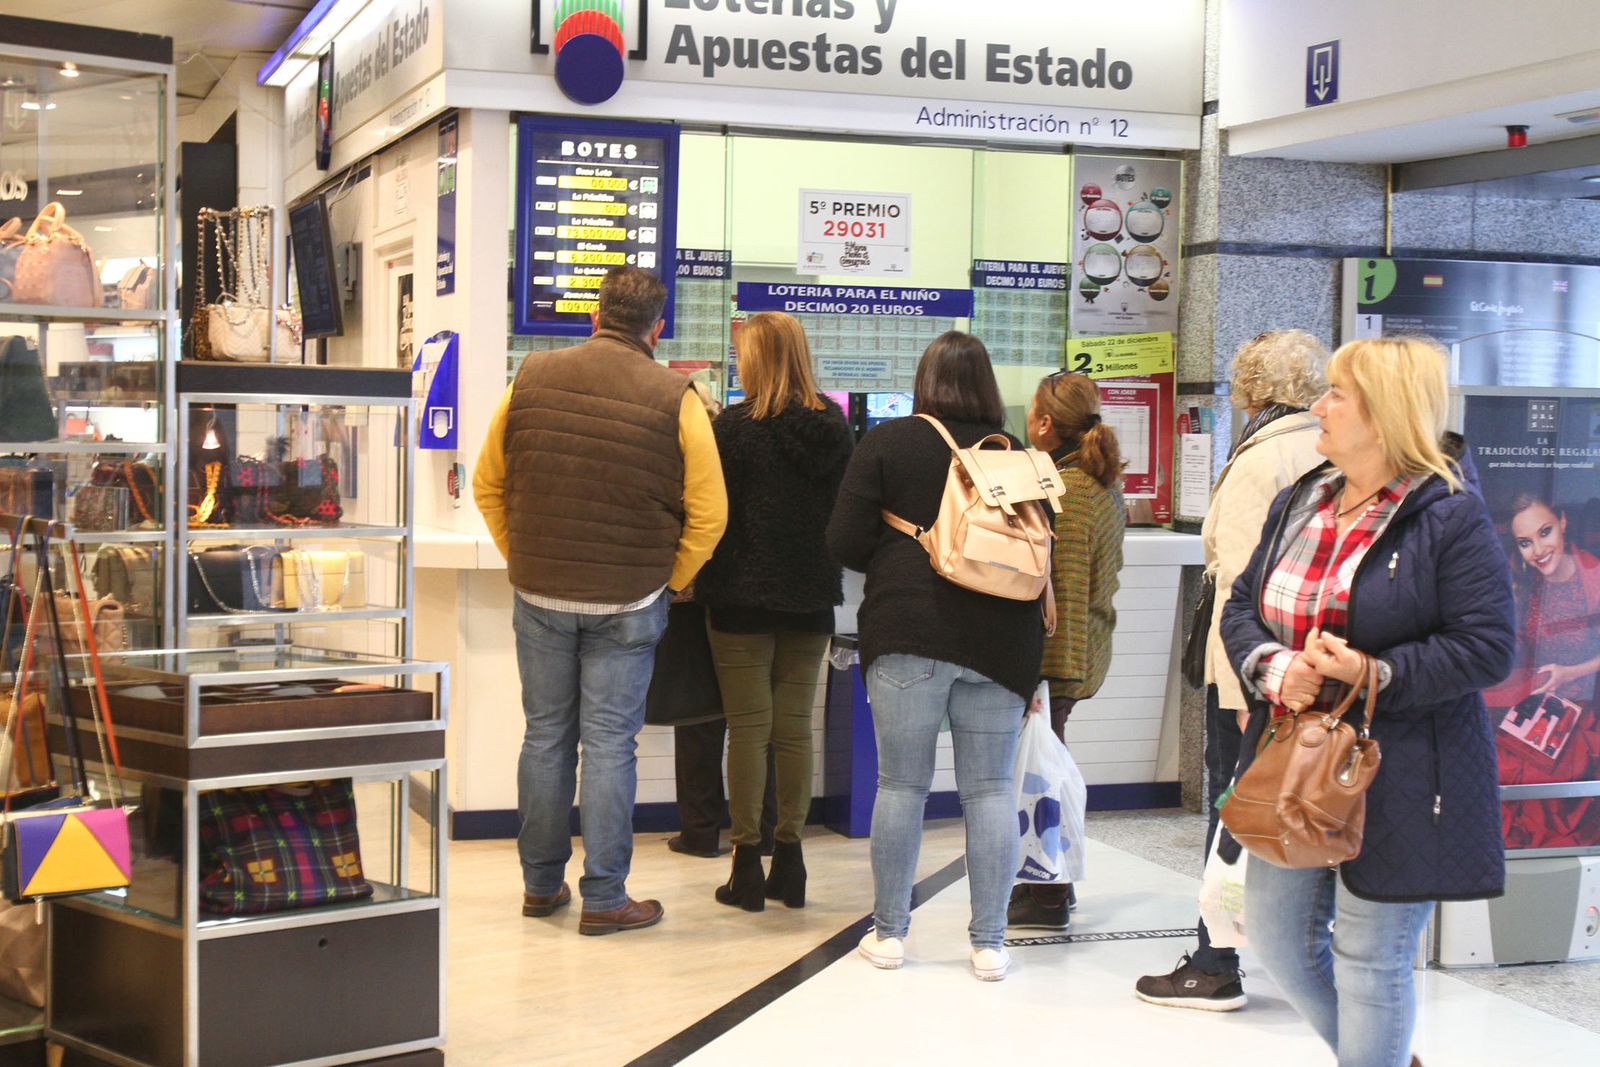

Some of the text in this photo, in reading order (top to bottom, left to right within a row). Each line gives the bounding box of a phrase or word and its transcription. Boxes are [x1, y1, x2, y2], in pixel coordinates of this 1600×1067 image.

[664, 24, 1133, 90] Apuestas del Estado
[916, 106, 1070, 134] Administración
[1110, 119, 1129, 137] 12
[561, 140, 638, 159] BOTES
[832, 201, 901, 218] PREMIO
[823, 220, 886, 238] 29031
[685, 250, 695, 260] EL
[697, 251, 730, 262] JUEVES
[692, 265, 724, 277] EUROS
[975, 261, 1006, 272] LOTERIA
[1008, 262, 1028, 273] PARA
[1030, 264, 1041, 273] EL
[986, 276, 1015, 286] DECIMO
[1037, 278, 1066, 289] EUROS
[768, 285, 941, 301] LOTERIA PARA EL NIÑO
[784, 301, 924, 316] DECIMO 20 EUROS
[1365, 315, 1372, 330] 1
[1127, 336, 1159, 345] diciembre
[1105, 363, 1138, 371] Millones
[1537, 437, 1549, 445] LA
[1478, 445, 1539, 456] TRADICIÓN
[1541, 447, 1556, 456] DE
[1005, 929, 1199, 947] ESPERE AQUÍ SU TURNO
